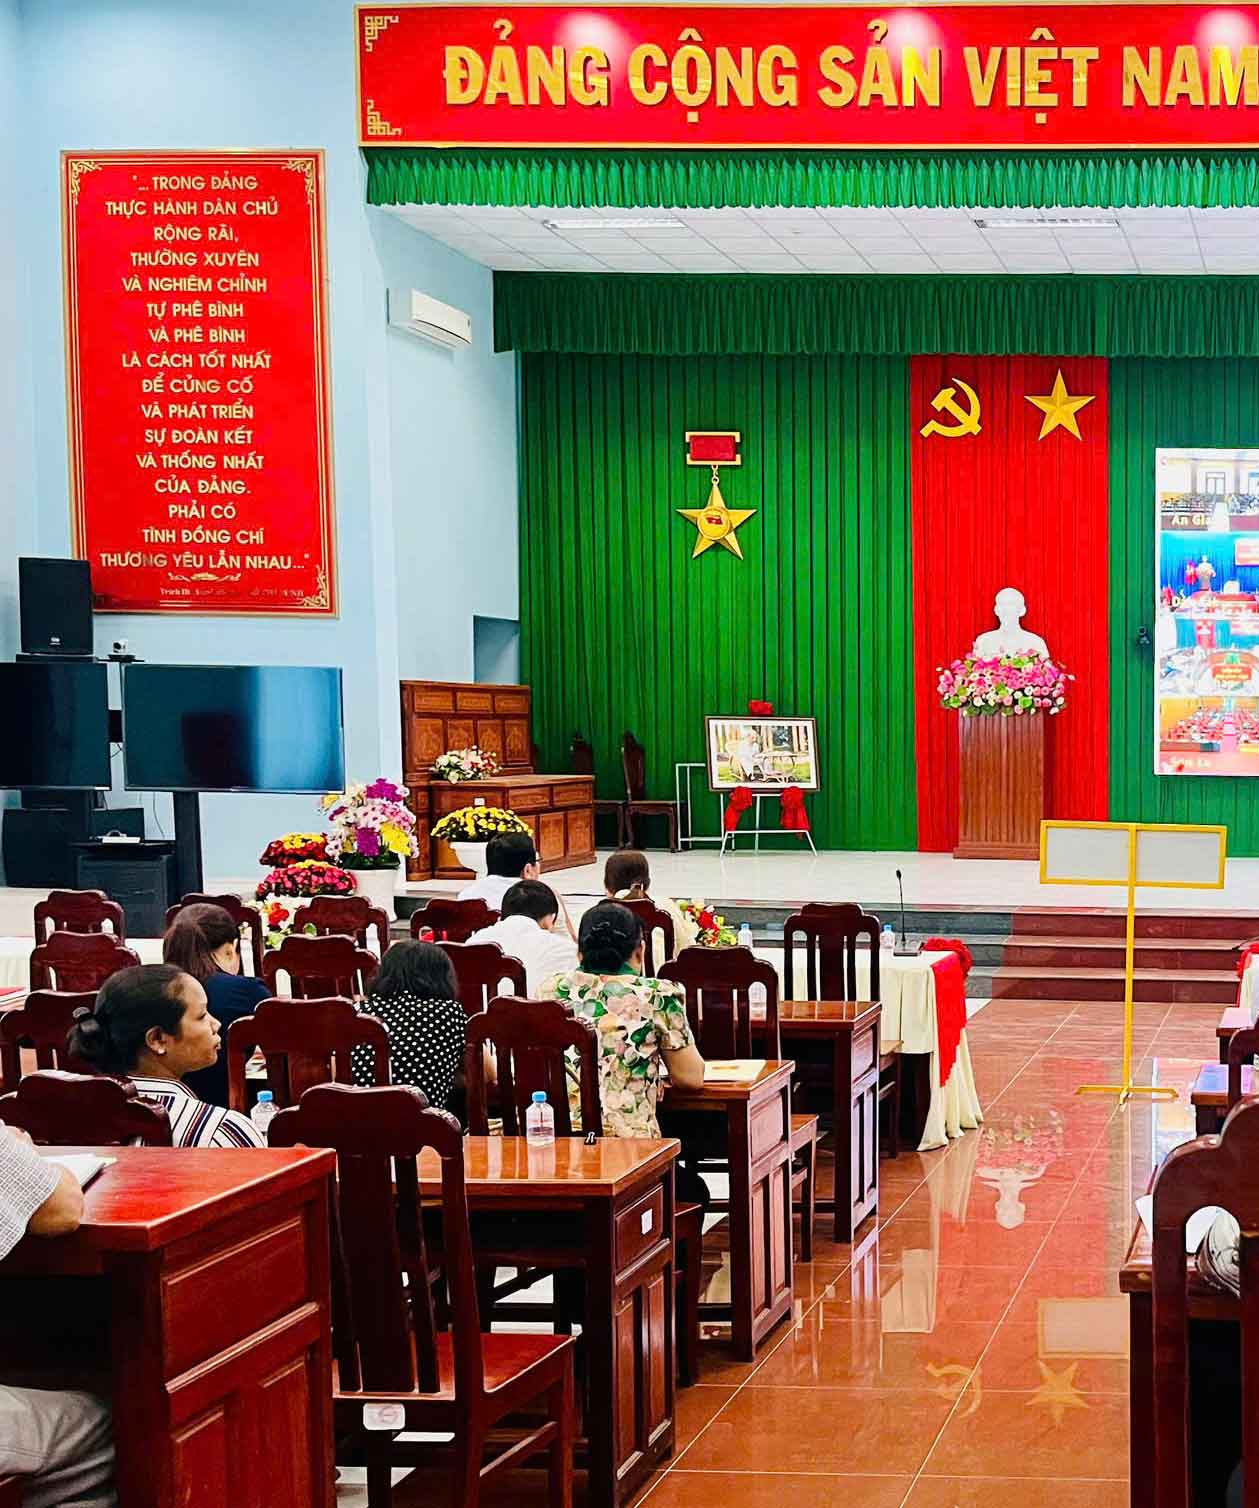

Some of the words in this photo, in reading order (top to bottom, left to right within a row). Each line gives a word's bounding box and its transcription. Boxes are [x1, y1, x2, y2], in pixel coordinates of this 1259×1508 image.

[446, 21, 609, 105] ĐẢNG
[629, 30, 797, 122] CỘNG
[819, 21, 941, 107] SẢN
[965, 28, 1098, 124] VIỆT
[211, 171, 258, 189] ĐẢNG
[105, 200, 147, 218] THỰC
[153, 199, 198, 215] HÀNH
[203, 199, 237, 214] DÂN
[242, 197, 278, 215] CHỦ
[153, 224, 202, 243] RỘNG
[204, 250, 259, 266] XUYÊN
[121, 275, 143, 291] VÀ
[148, 275, 213, 291] NGHIÊM
[217, 273, 267, 292] CHỈNH
[146, 302, 167, 320] TỰ
[172, 300, 203, 316] PHÊ
[208, 301, 244, 317] BÌNH
[148, 326, 170, 343] VÀ
[173, 326, 204, 342] PHÊ
[209, 327, 245, 342] BÌNH
[122, 352, 142, 367] LÀ
[146, 351, 193, 368] CÁCH
[199, 350, 226, 367] TỐT
[231, 350, 272, 368] NHẤT
[142, 373, 164, 392] ĐỂ
[169, 375, 221, 392] CỦNG
[226, 376, 254, 392] CỐ
[141, 402, 163, 418] VÀ
[168, 402, 207, 418] PHÁT
[210, 399, 254, 419] TRIỂN
[145, 428, 167, 446] SỰ
[171, 427, 219, 443] ĐOÀN
[224, 425, 253, 444] KẾT
[135, 452, 158, 468] VÀ
[160, 450, 217, 468] THỐNG
[223, 451, 264, 468] NHẤT
[154, 475, 192, 493] CỦA
[168, 500, 205, 518] PHẢI
[210, 503, 237, 518] CÓ
[142, 527, 176, 542] TÌNH
[181, 525, 231, 543] ĐỒNG
[235, 528, 264, 544] CHÍ
[100, 552, 168, 567] THƯƠNG
[173, 552, 204, 568] YÊU
[209, 550, 241, 568] LẪN
